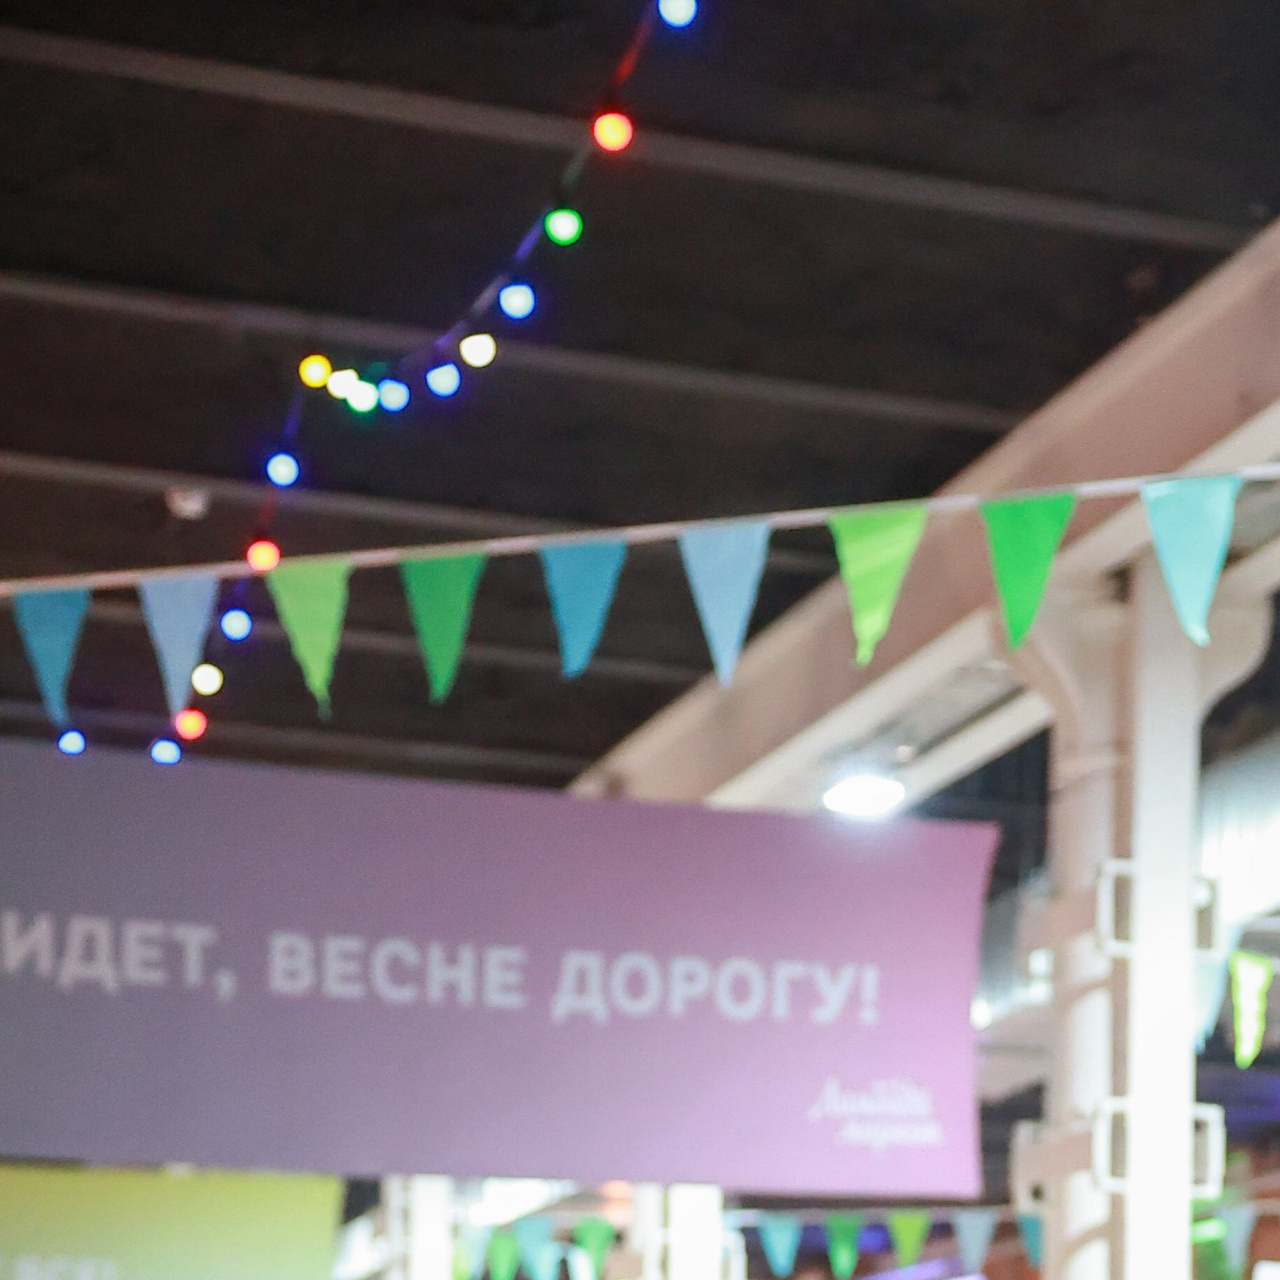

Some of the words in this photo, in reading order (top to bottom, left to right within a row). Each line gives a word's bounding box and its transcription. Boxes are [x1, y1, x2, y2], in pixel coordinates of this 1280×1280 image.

[0, 911, 238, 999] ИДЕТ,
[268, 930, 528, 1009] ВЕСНЕ
[552, 949, 881, 1026] ДОРОГУ!
